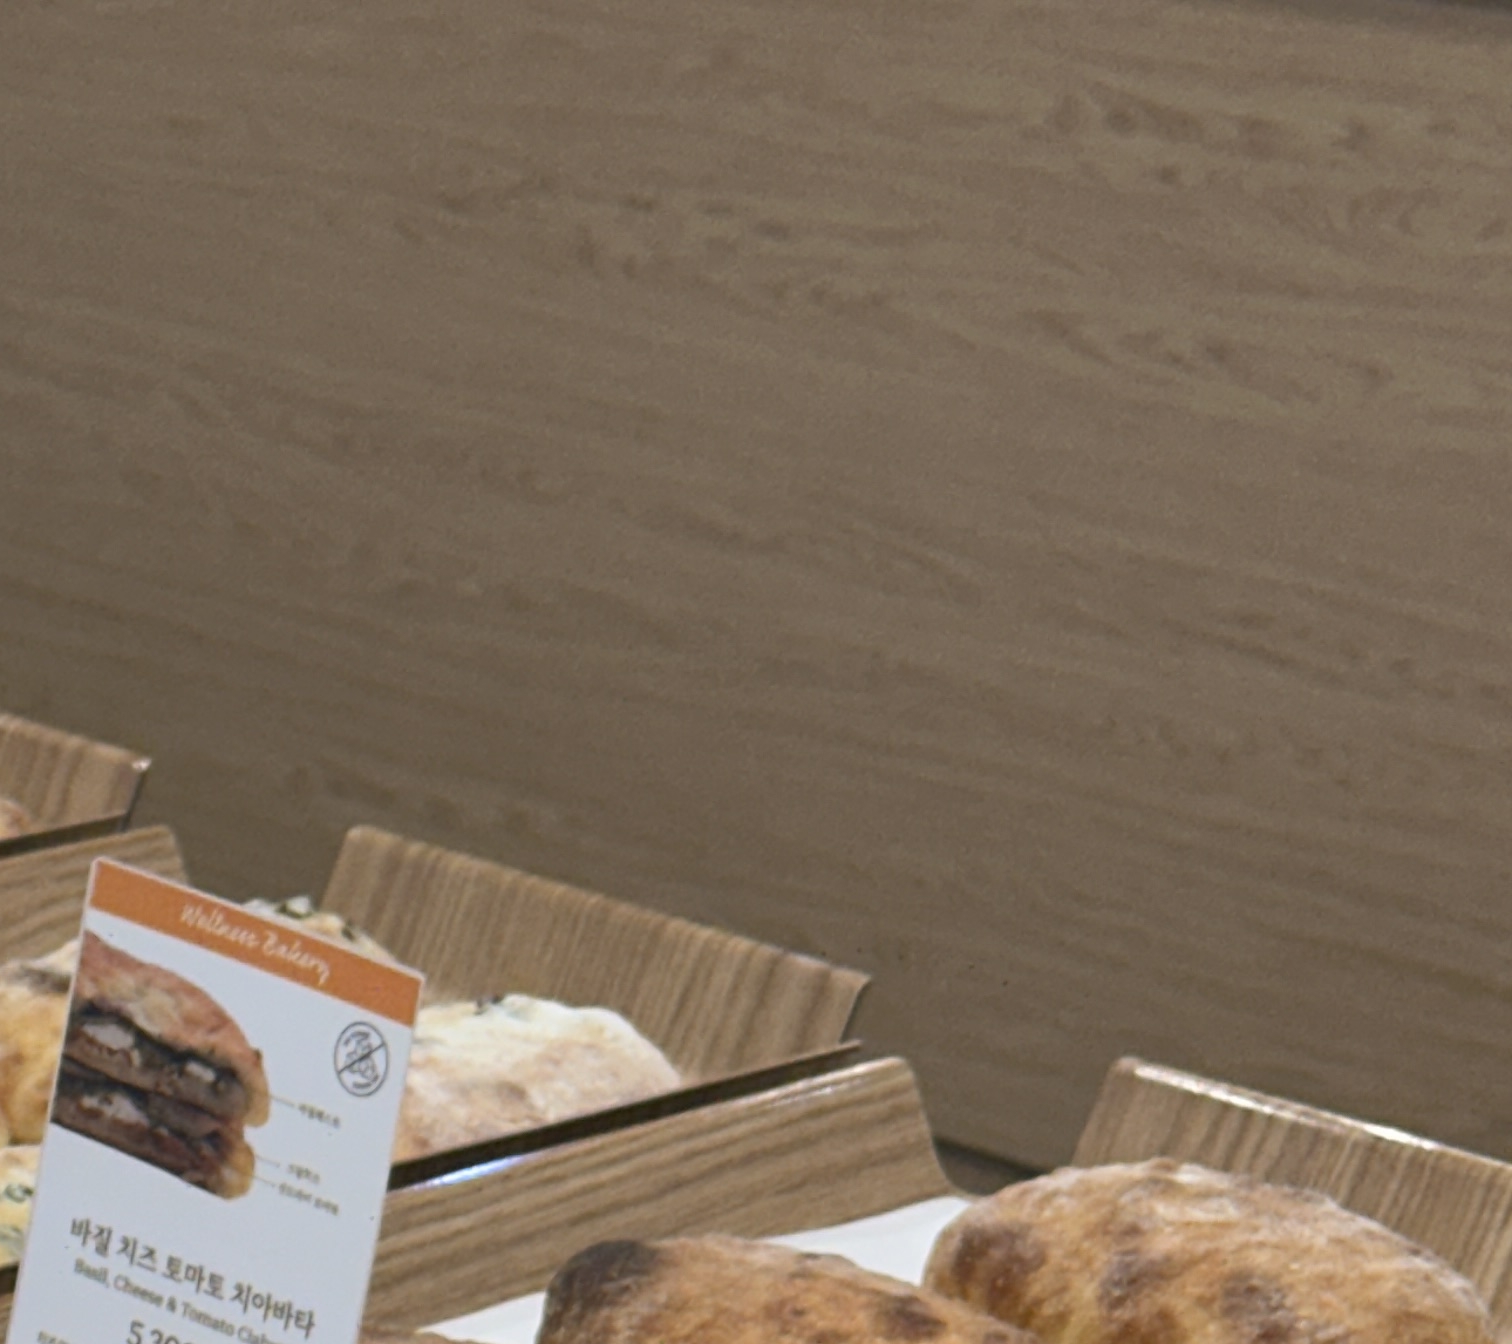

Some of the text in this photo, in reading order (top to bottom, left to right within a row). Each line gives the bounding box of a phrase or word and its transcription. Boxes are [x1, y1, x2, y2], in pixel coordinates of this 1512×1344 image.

[262, 930, 330, 986] Bakery
[70, 1218, 316, 1340] 바질 치즈 토마토 치아바타
[73, 1257, 110, 1289] Basil,
[113, 1274, 164, 1308] Cheese
[165, 1296, 177, 1314] &
[181, 1301, 236, 1337] Tomato
